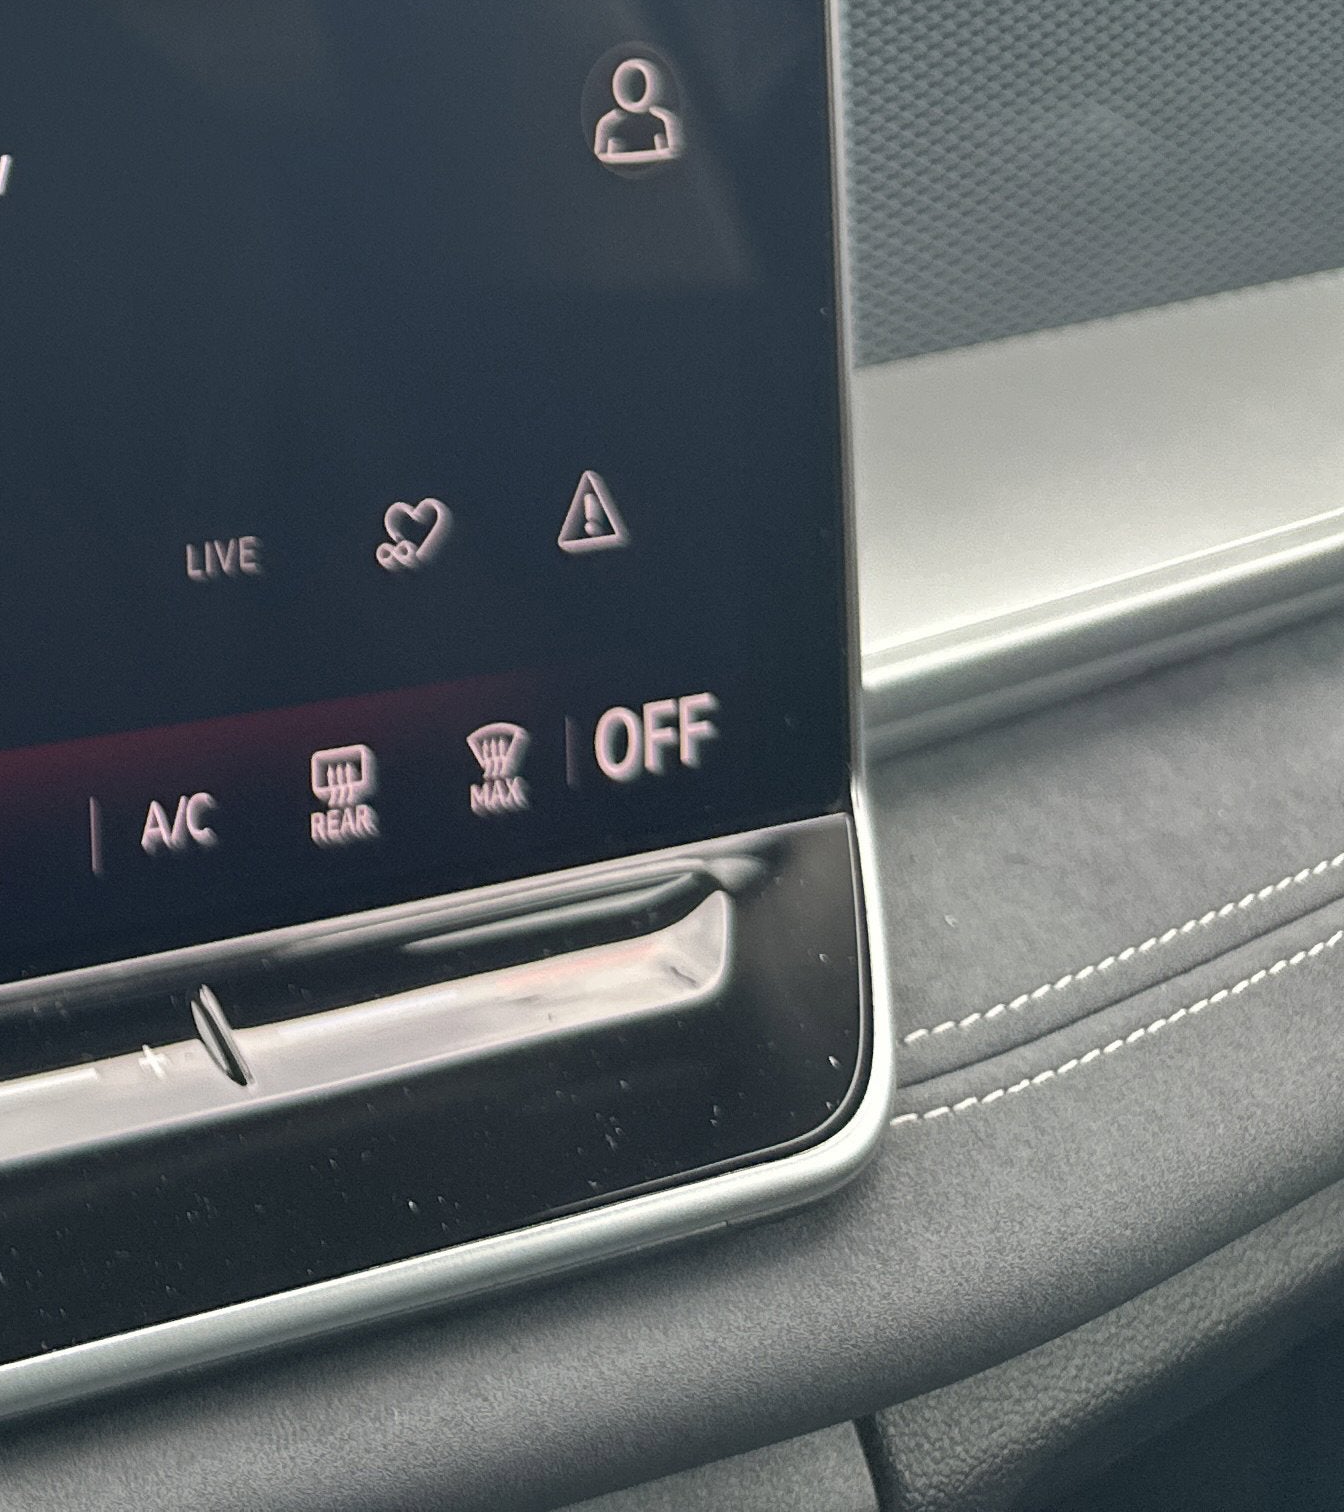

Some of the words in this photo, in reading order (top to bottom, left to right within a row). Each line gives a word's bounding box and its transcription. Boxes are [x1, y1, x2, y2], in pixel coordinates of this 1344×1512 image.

[186, 535, 264, 581] LIVE
[593, 691, 720, 782] OFF
[470, 776, 529, 815] MAX
[141, 792, 217, 855] A/C
[311, 803, 379, 848] REAR
